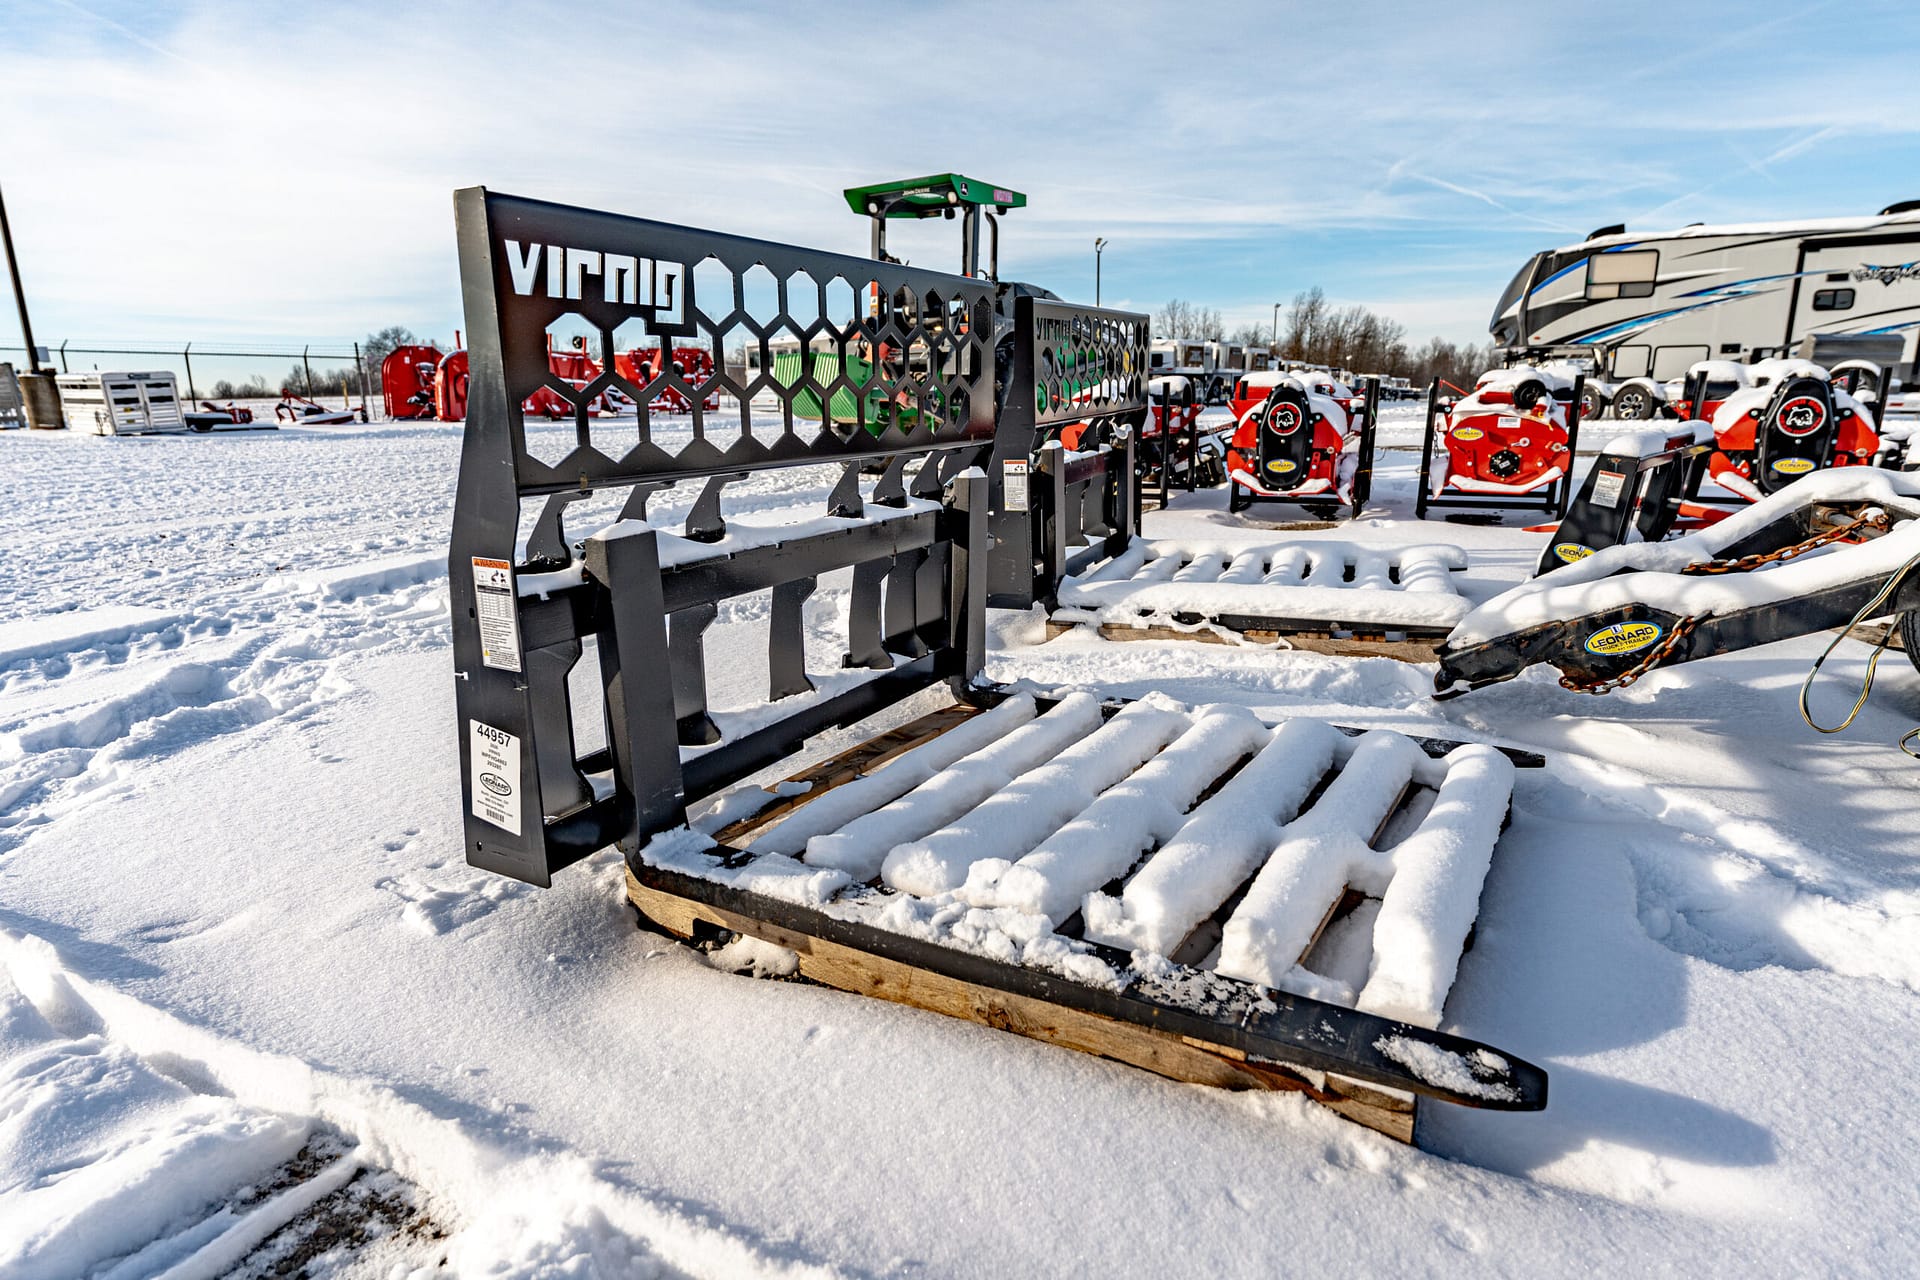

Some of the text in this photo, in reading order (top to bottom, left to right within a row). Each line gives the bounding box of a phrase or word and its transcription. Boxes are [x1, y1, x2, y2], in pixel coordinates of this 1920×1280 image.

[1558, 547, 1588, 559] LEONA
[1590, 626, 1654, 648] LEONARD
[1598, 644, 1618, 652] TRUCK
[1625, 635, 1652, 646] TRAILER
[477, 724, 511, 747] 44957
